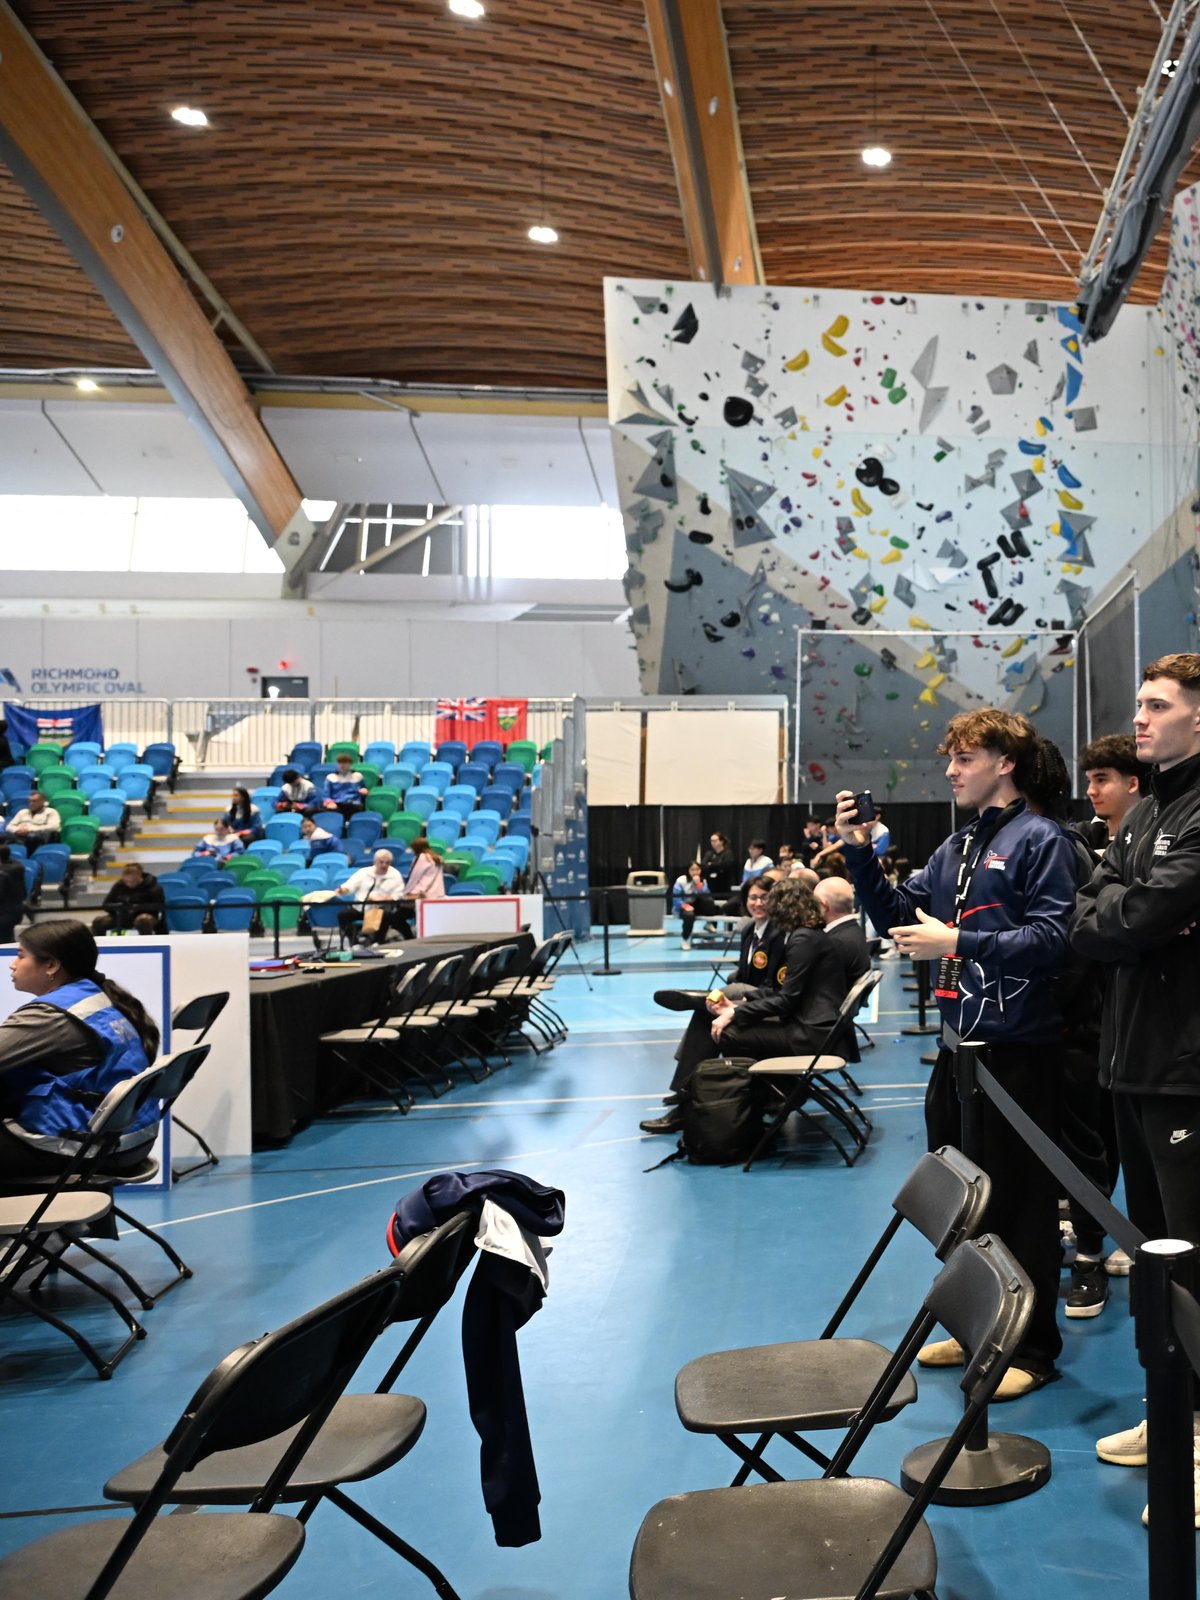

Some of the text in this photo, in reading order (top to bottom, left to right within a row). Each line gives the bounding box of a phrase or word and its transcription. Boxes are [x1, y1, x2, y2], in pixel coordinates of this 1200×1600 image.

[31, 667, 120, 680] RICHMOND
[31, 681, 146, 694] OLYMPIC OVAL
